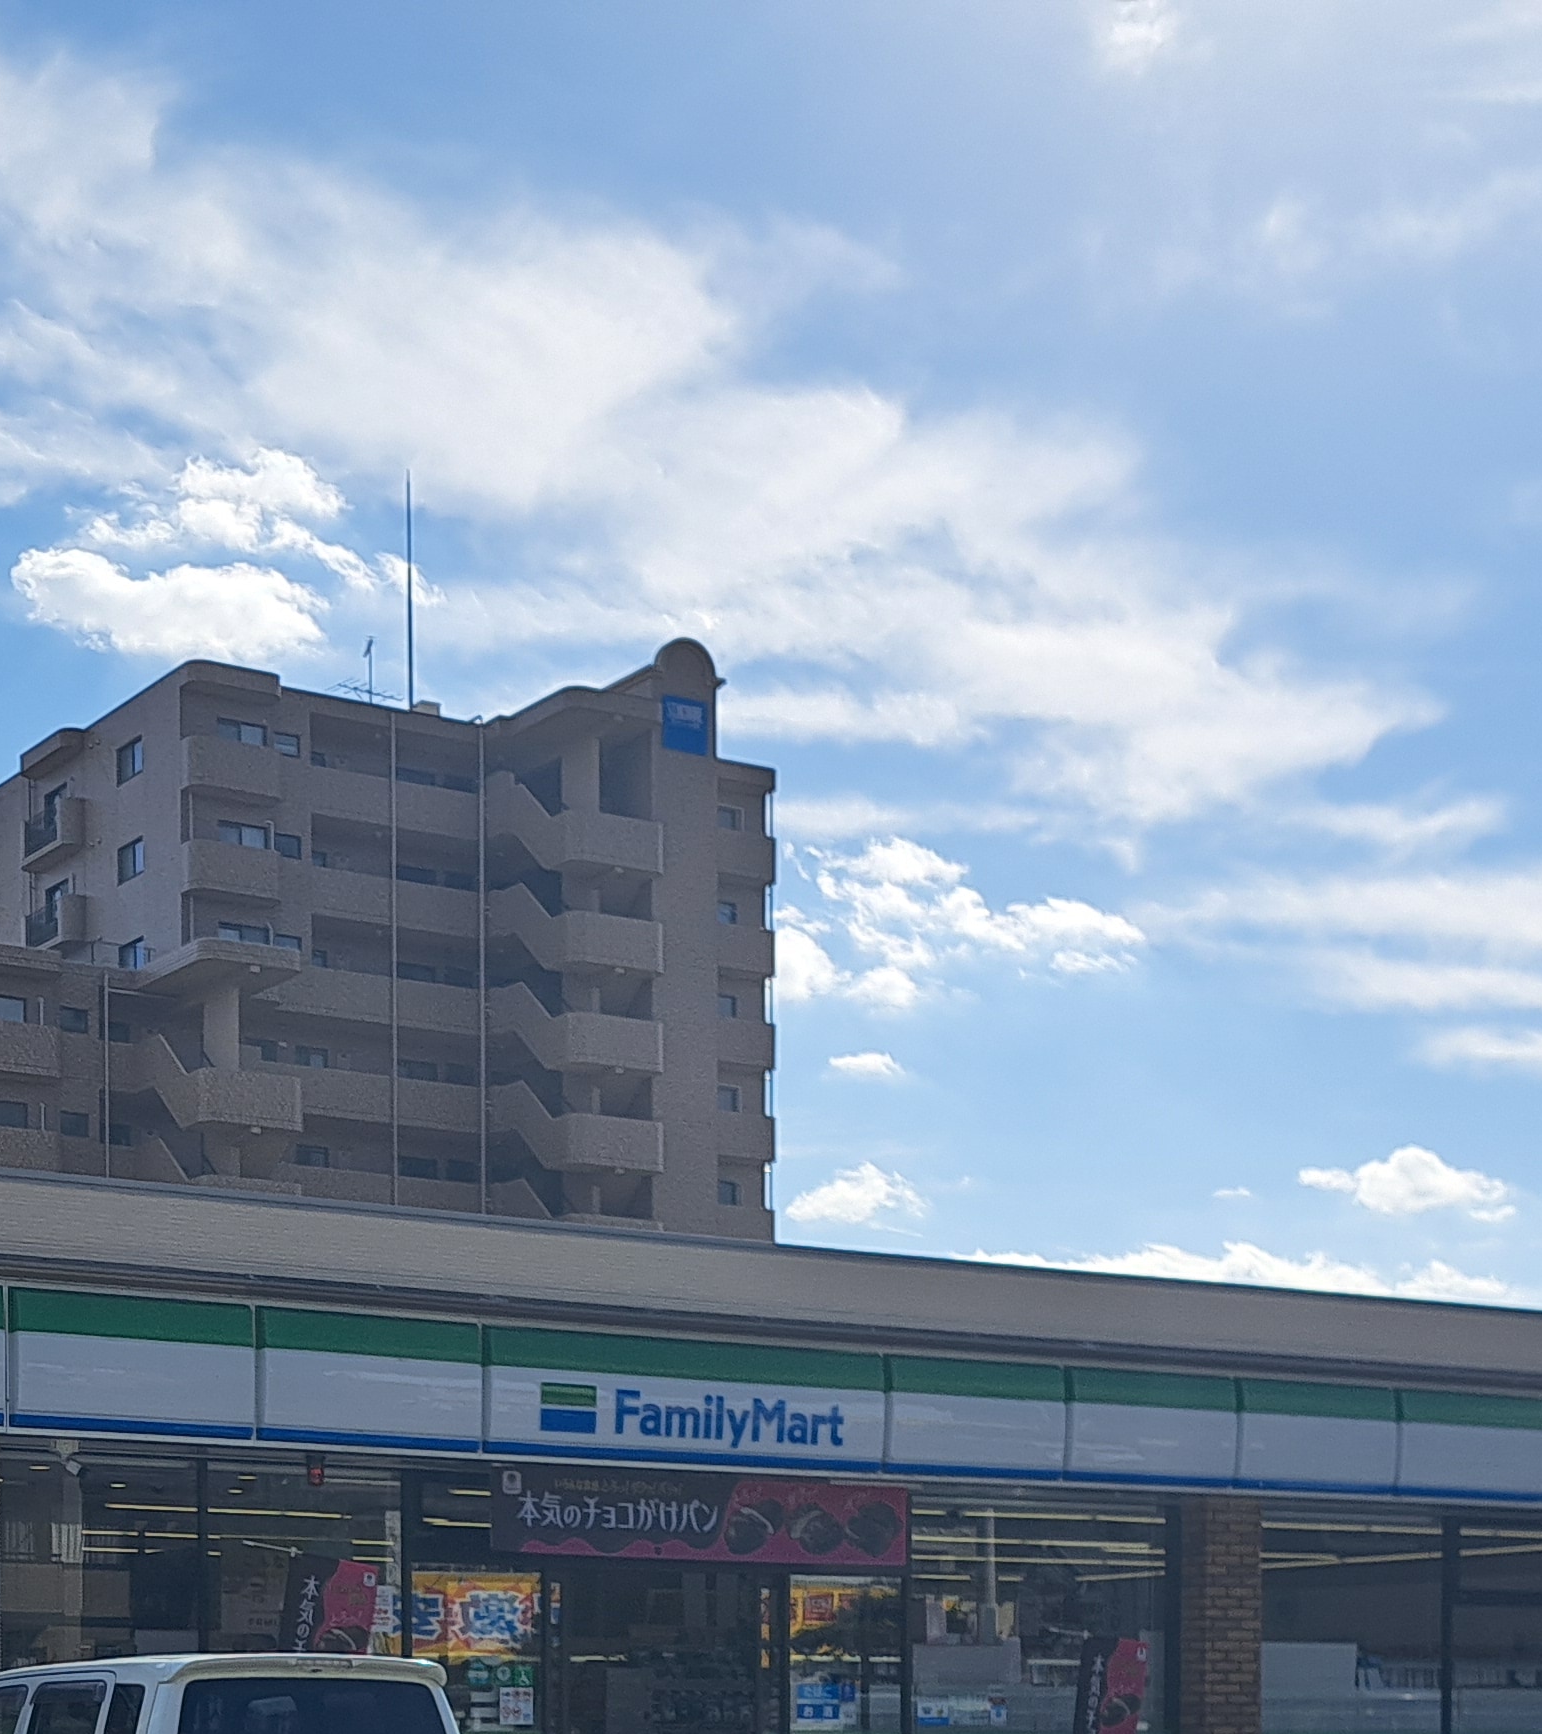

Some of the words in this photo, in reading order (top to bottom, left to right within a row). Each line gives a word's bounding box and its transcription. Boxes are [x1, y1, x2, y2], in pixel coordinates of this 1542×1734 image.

[614, 1388, 845, 1450] FamilyMart
[517, 1490, 718, 1533] 本気のチョコがけパン
